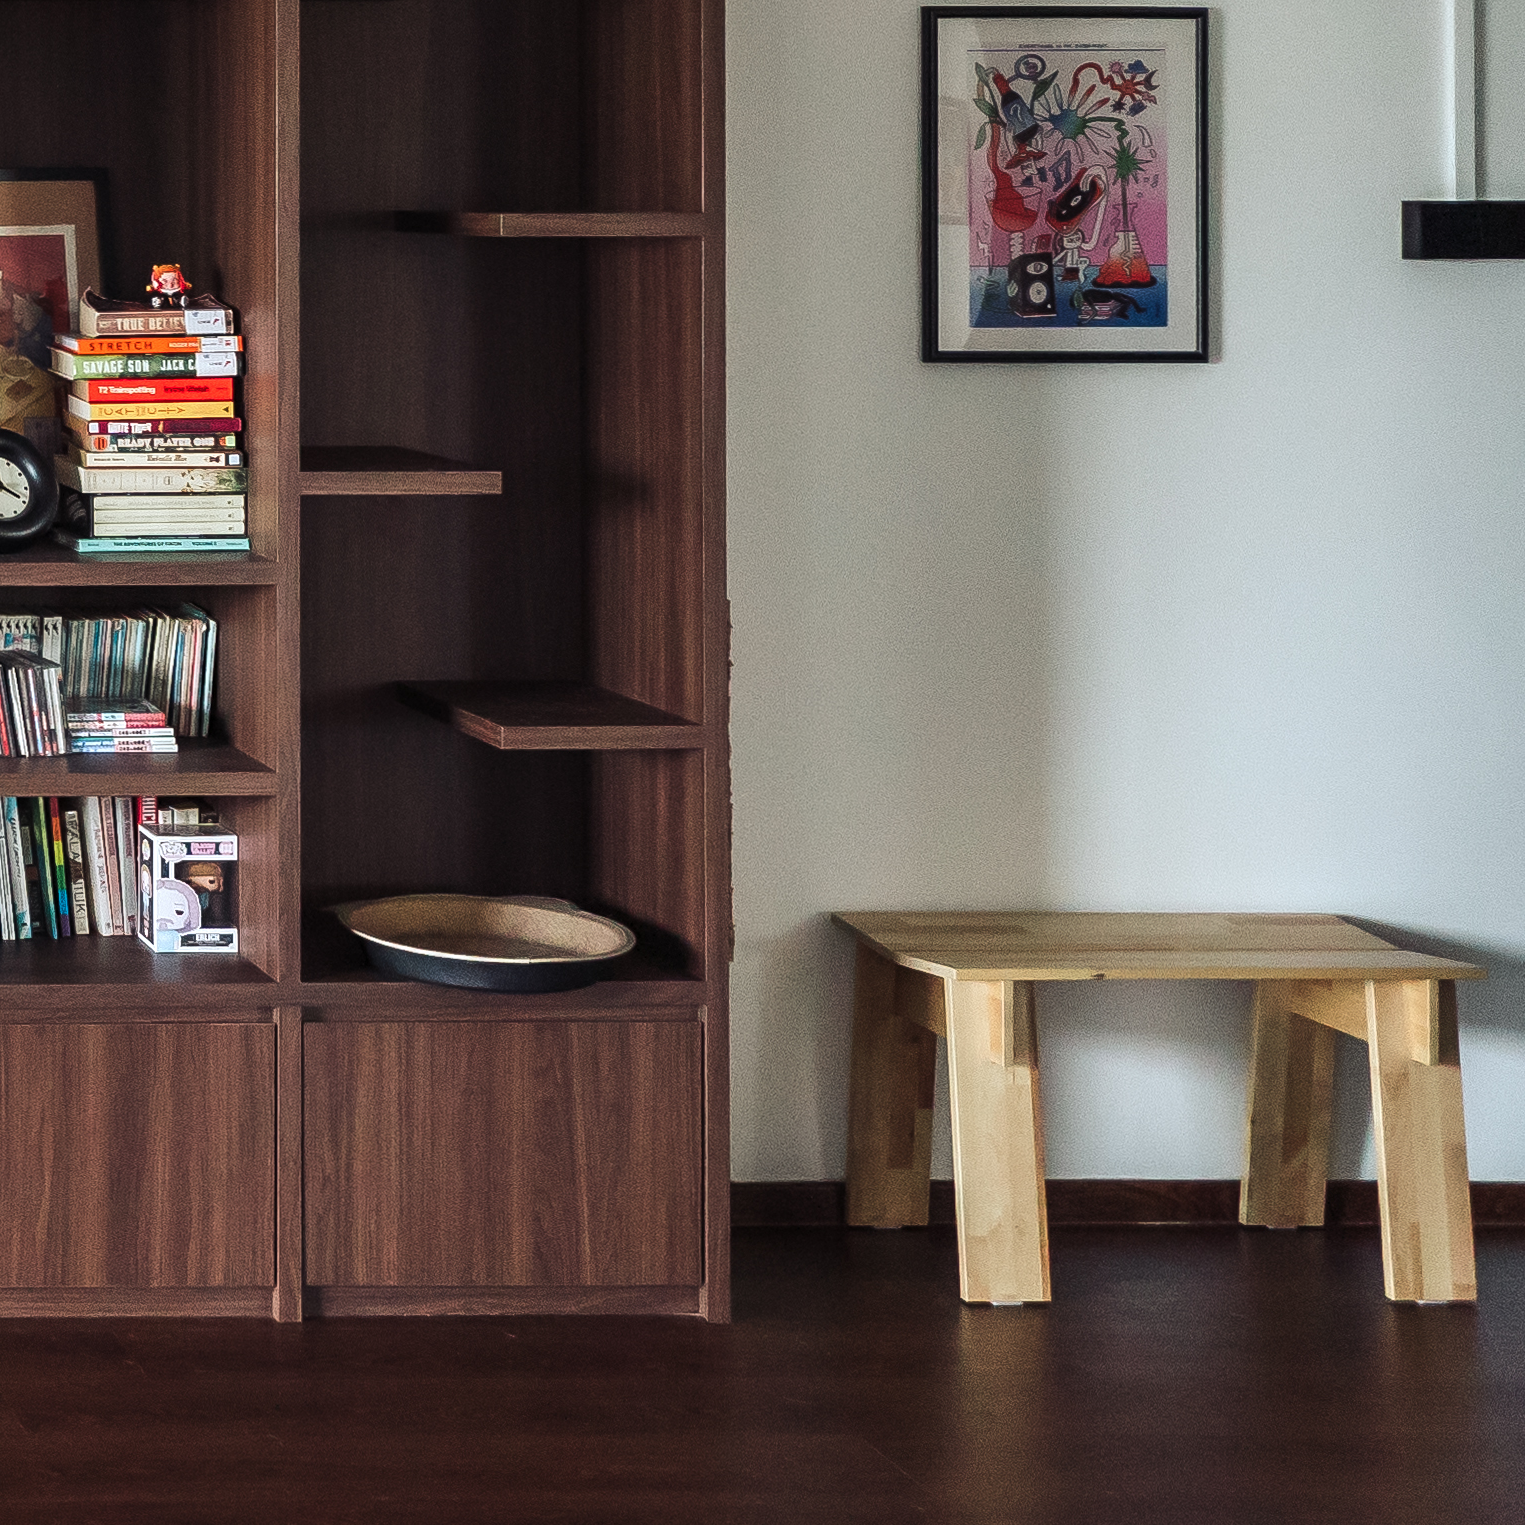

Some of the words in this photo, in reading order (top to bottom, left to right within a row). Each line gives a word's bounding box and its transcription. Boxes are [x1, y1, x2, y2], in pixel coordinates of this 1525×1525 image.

[116, 317, 145, 331] TRUE
[149, 317, 186, 330] BELIEV
[89, 341, 153, 351] STRETCH
[83, 360, 125, 374] SAVAGE
[127, 360, 150, 372] SON
[160, 358, 186, 370] JACK
[98, 386, 108, 394] T2
[109, 385, 156, 395] Trainspotting
[103, 407, 135, 416] CAT
[147, 406, 186, 415] CITY
[117, 438, 150, 449] READY
[153, 437, 192, 449] PLAYER
[193, 437, 215, 446] ONE
[141, 796, 156, 824] HUC
